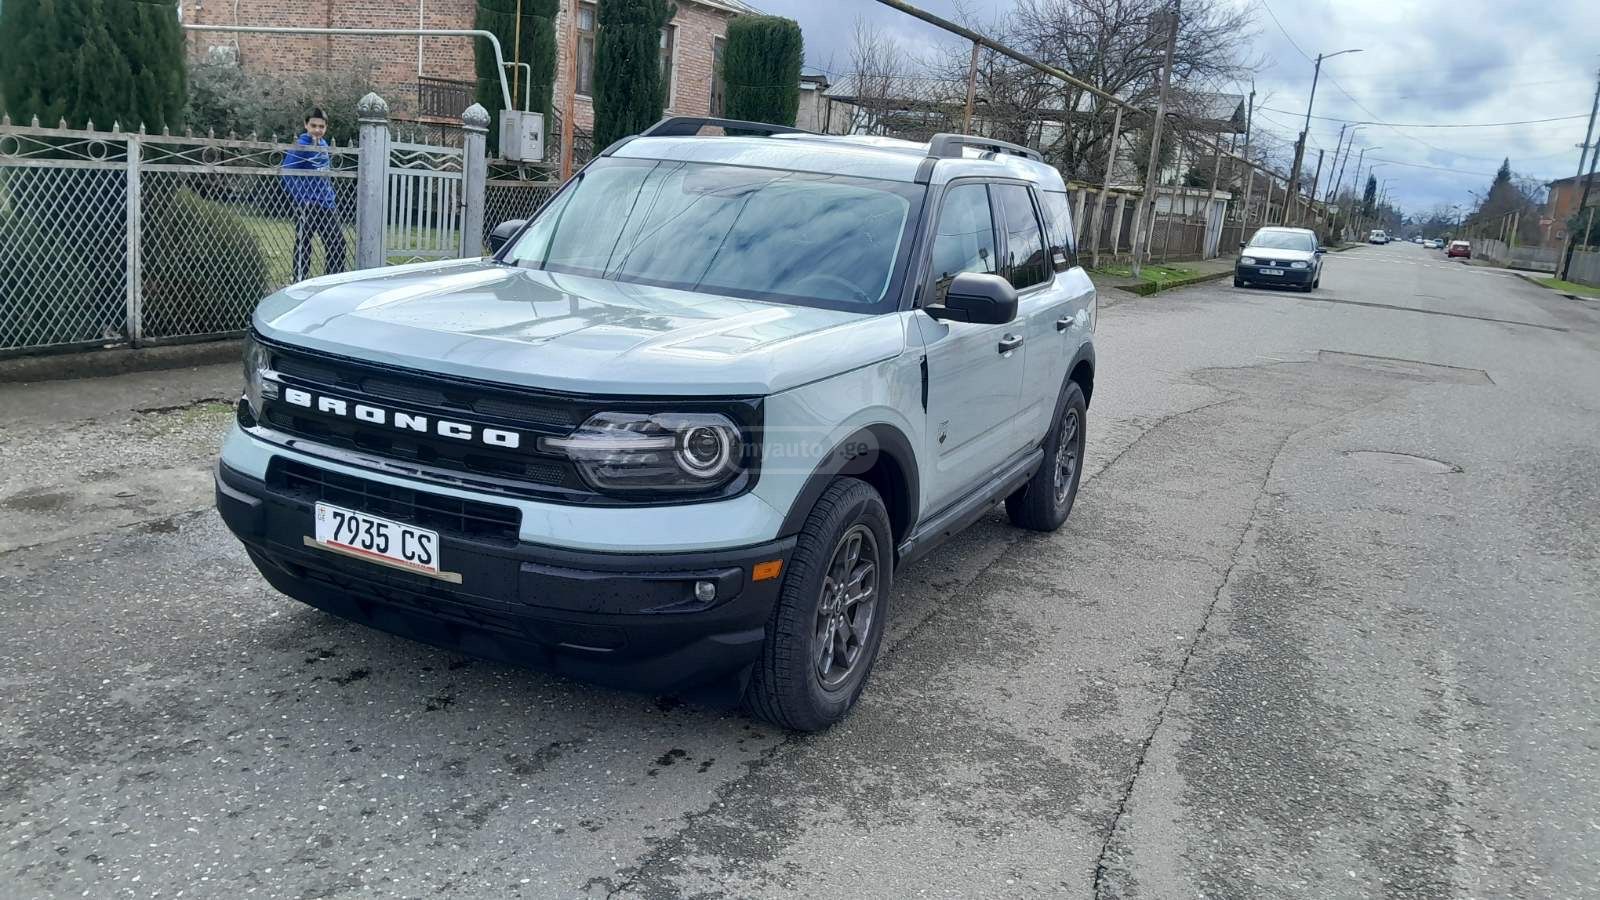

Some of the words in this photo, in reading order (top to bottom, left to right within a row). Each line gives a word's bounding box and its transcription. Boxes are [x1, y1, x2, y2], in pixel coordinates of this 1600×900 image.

[285, 388, 519, 449] BRONCO
[333, 511, 389, 554] 7935
[402, 530, 432, 565] CS
